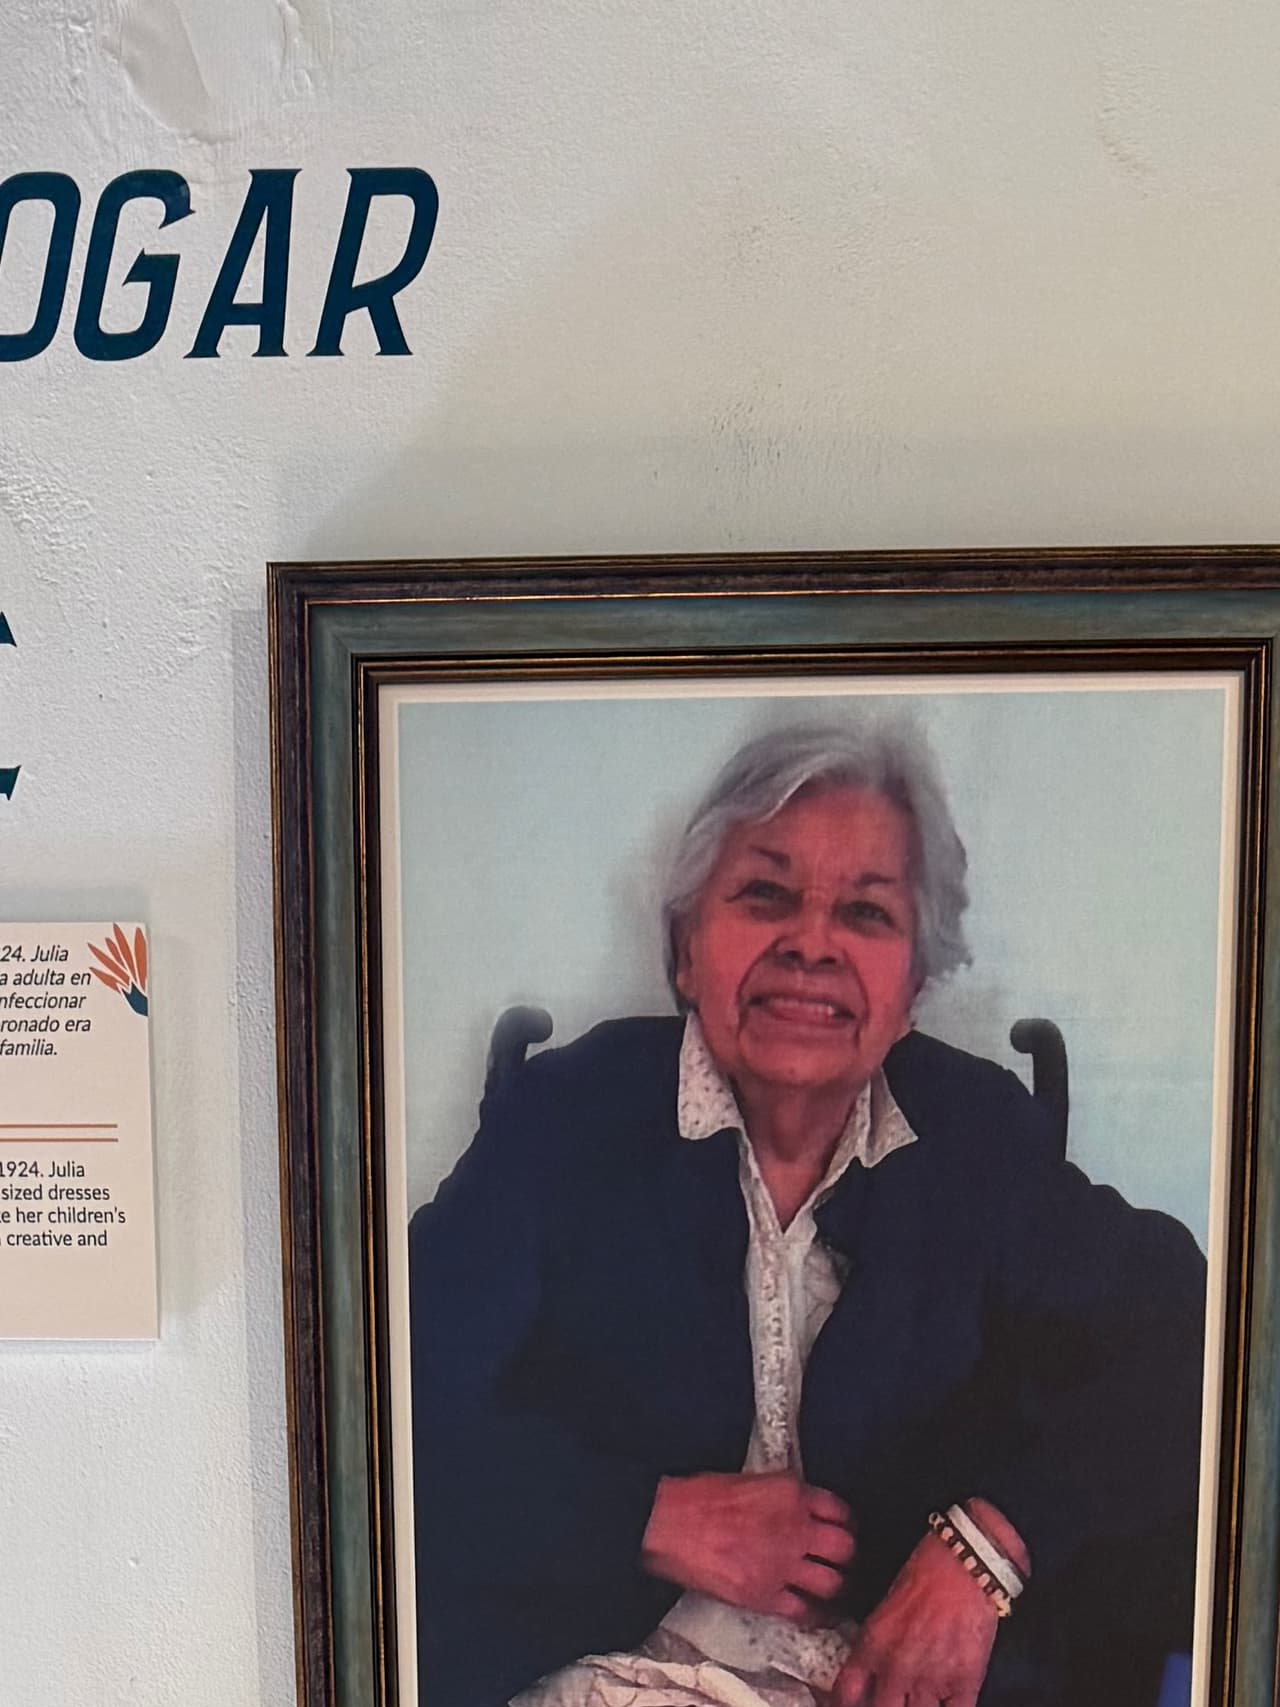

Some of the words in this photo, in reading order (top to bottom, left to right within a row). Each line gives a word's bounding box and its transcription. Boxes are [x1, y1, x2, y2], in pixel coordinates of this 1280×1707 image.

[29, 944, 69, 963] Julia
[47, 1183, 111, 1201] dresses
[6, 1228, 73, 1247] creative
[77, 1228, 108, 1247] and
